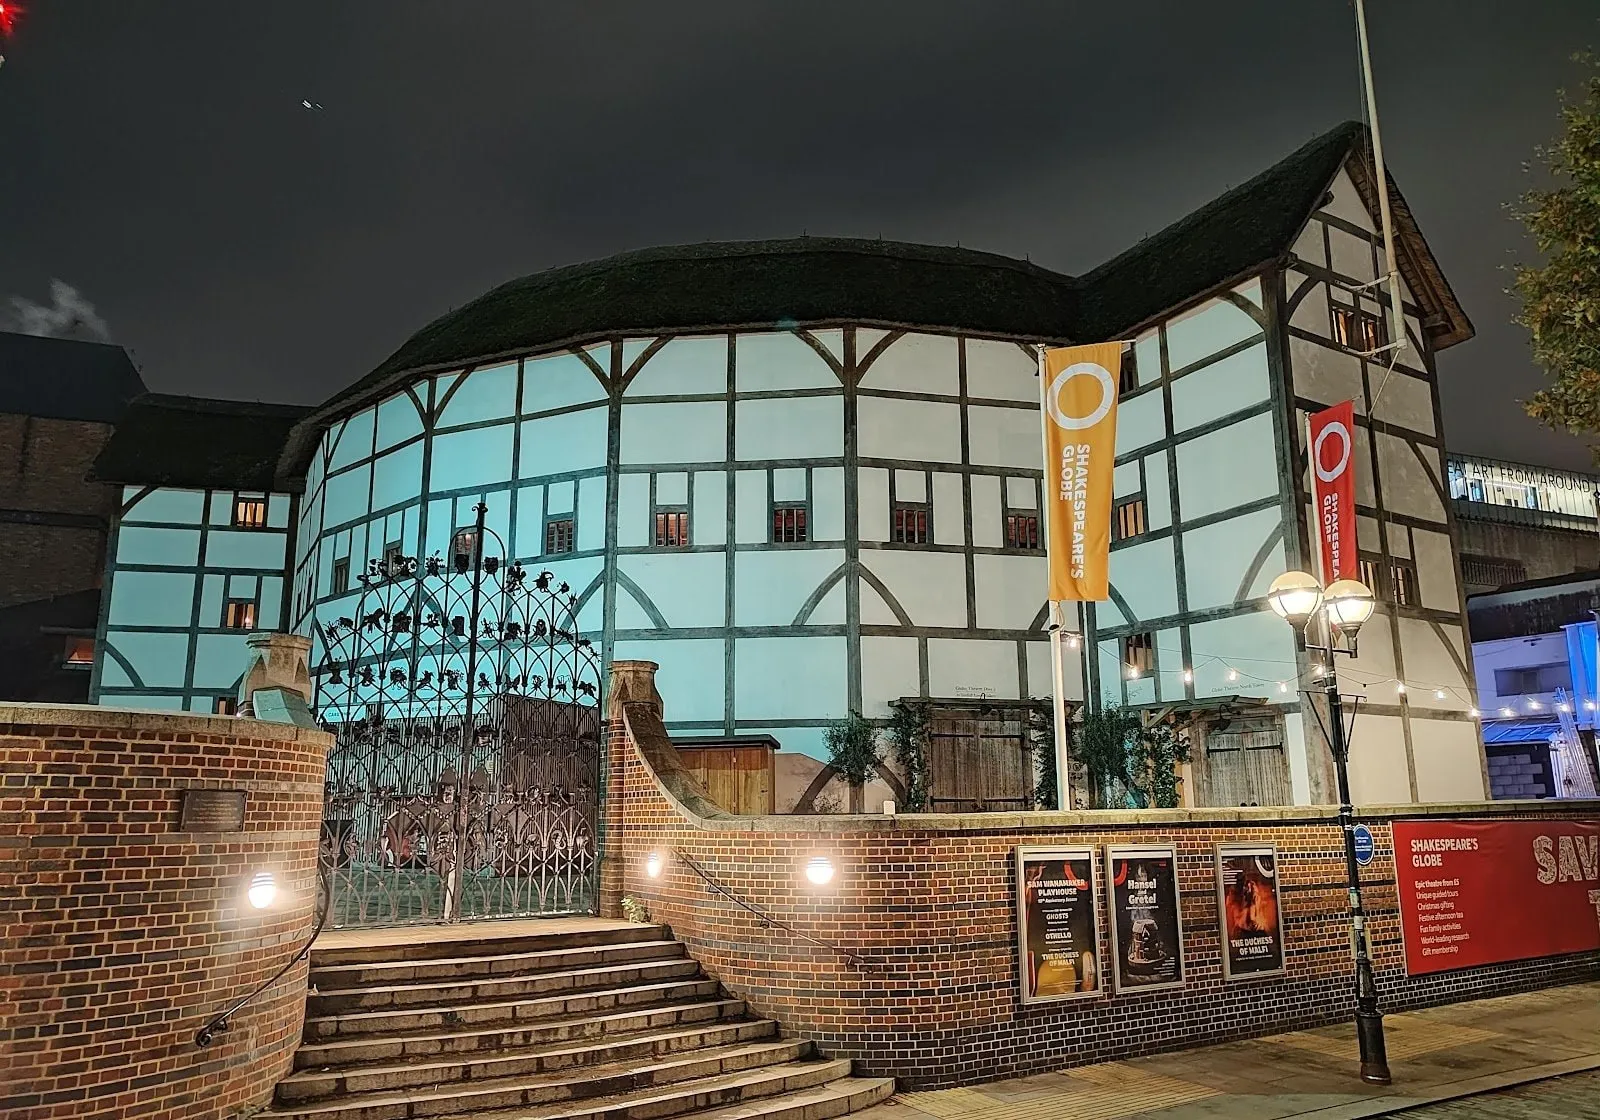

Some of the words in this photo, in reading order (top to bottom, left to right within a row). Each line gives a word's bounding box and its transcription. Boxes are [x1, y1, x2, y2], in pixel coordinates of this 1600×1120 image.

[1060, 445, 1075, 501] GLOBE
[1473, 463, 1494, 479] ART
[1500, 467, 1536, 484] FROM
[1540, 473, 1590, 492] AROUND
[1071, 444, 1091, 579] SHAKESPEARE'S
[1331, 492, 1341, 581] SHAKESPEA
[1410, 837, 1479, 853] SHAKESPEARE'S
[1412, 853, 1443, 868] GLOBE
[1027, 880, 1043, 888] SAM
[1043, 879, 1086, 888] WANAMAKER
[1127, 878, 1157, 889] Hansel
[1414, 880, 1425, 890] Epic
[1425, 880, 1443, 888] theatre
[1443, 879, 1454, 887] from
[1037, 888, 1077, 897] PLAYHOUSE
[1416, 892, 1432, 900] Unique
[1432, 890, 1447, 900] guided
[1128, 893, 1157, 905] Gretel
[1417, 902, 1440, 910] Christmas
[1440, 901, 1455, 910] gifting
[1046, 912, 1069, 920] GHOSTS
[1418, 913, 1435, 922] Festive
[1435, 912, 1456, 921] afternoon
[1420, 925, 1428, 933] Fun
[1428, 924, 1442, 934] family
[1442, 922, 1461, 930] activities
[1045, 932, 1072, 940] OTHELLO
[1230, 939, 1244, 948] THE
[1244, 936, 1274, 947] DUCHESS
[1054, 951, 1079, 960] DUCHESS
[1239, 947, 1248, 955] OF
[1248, 945, 1269, 954] MALFI
[1431, 945, 1459, 955] membership
